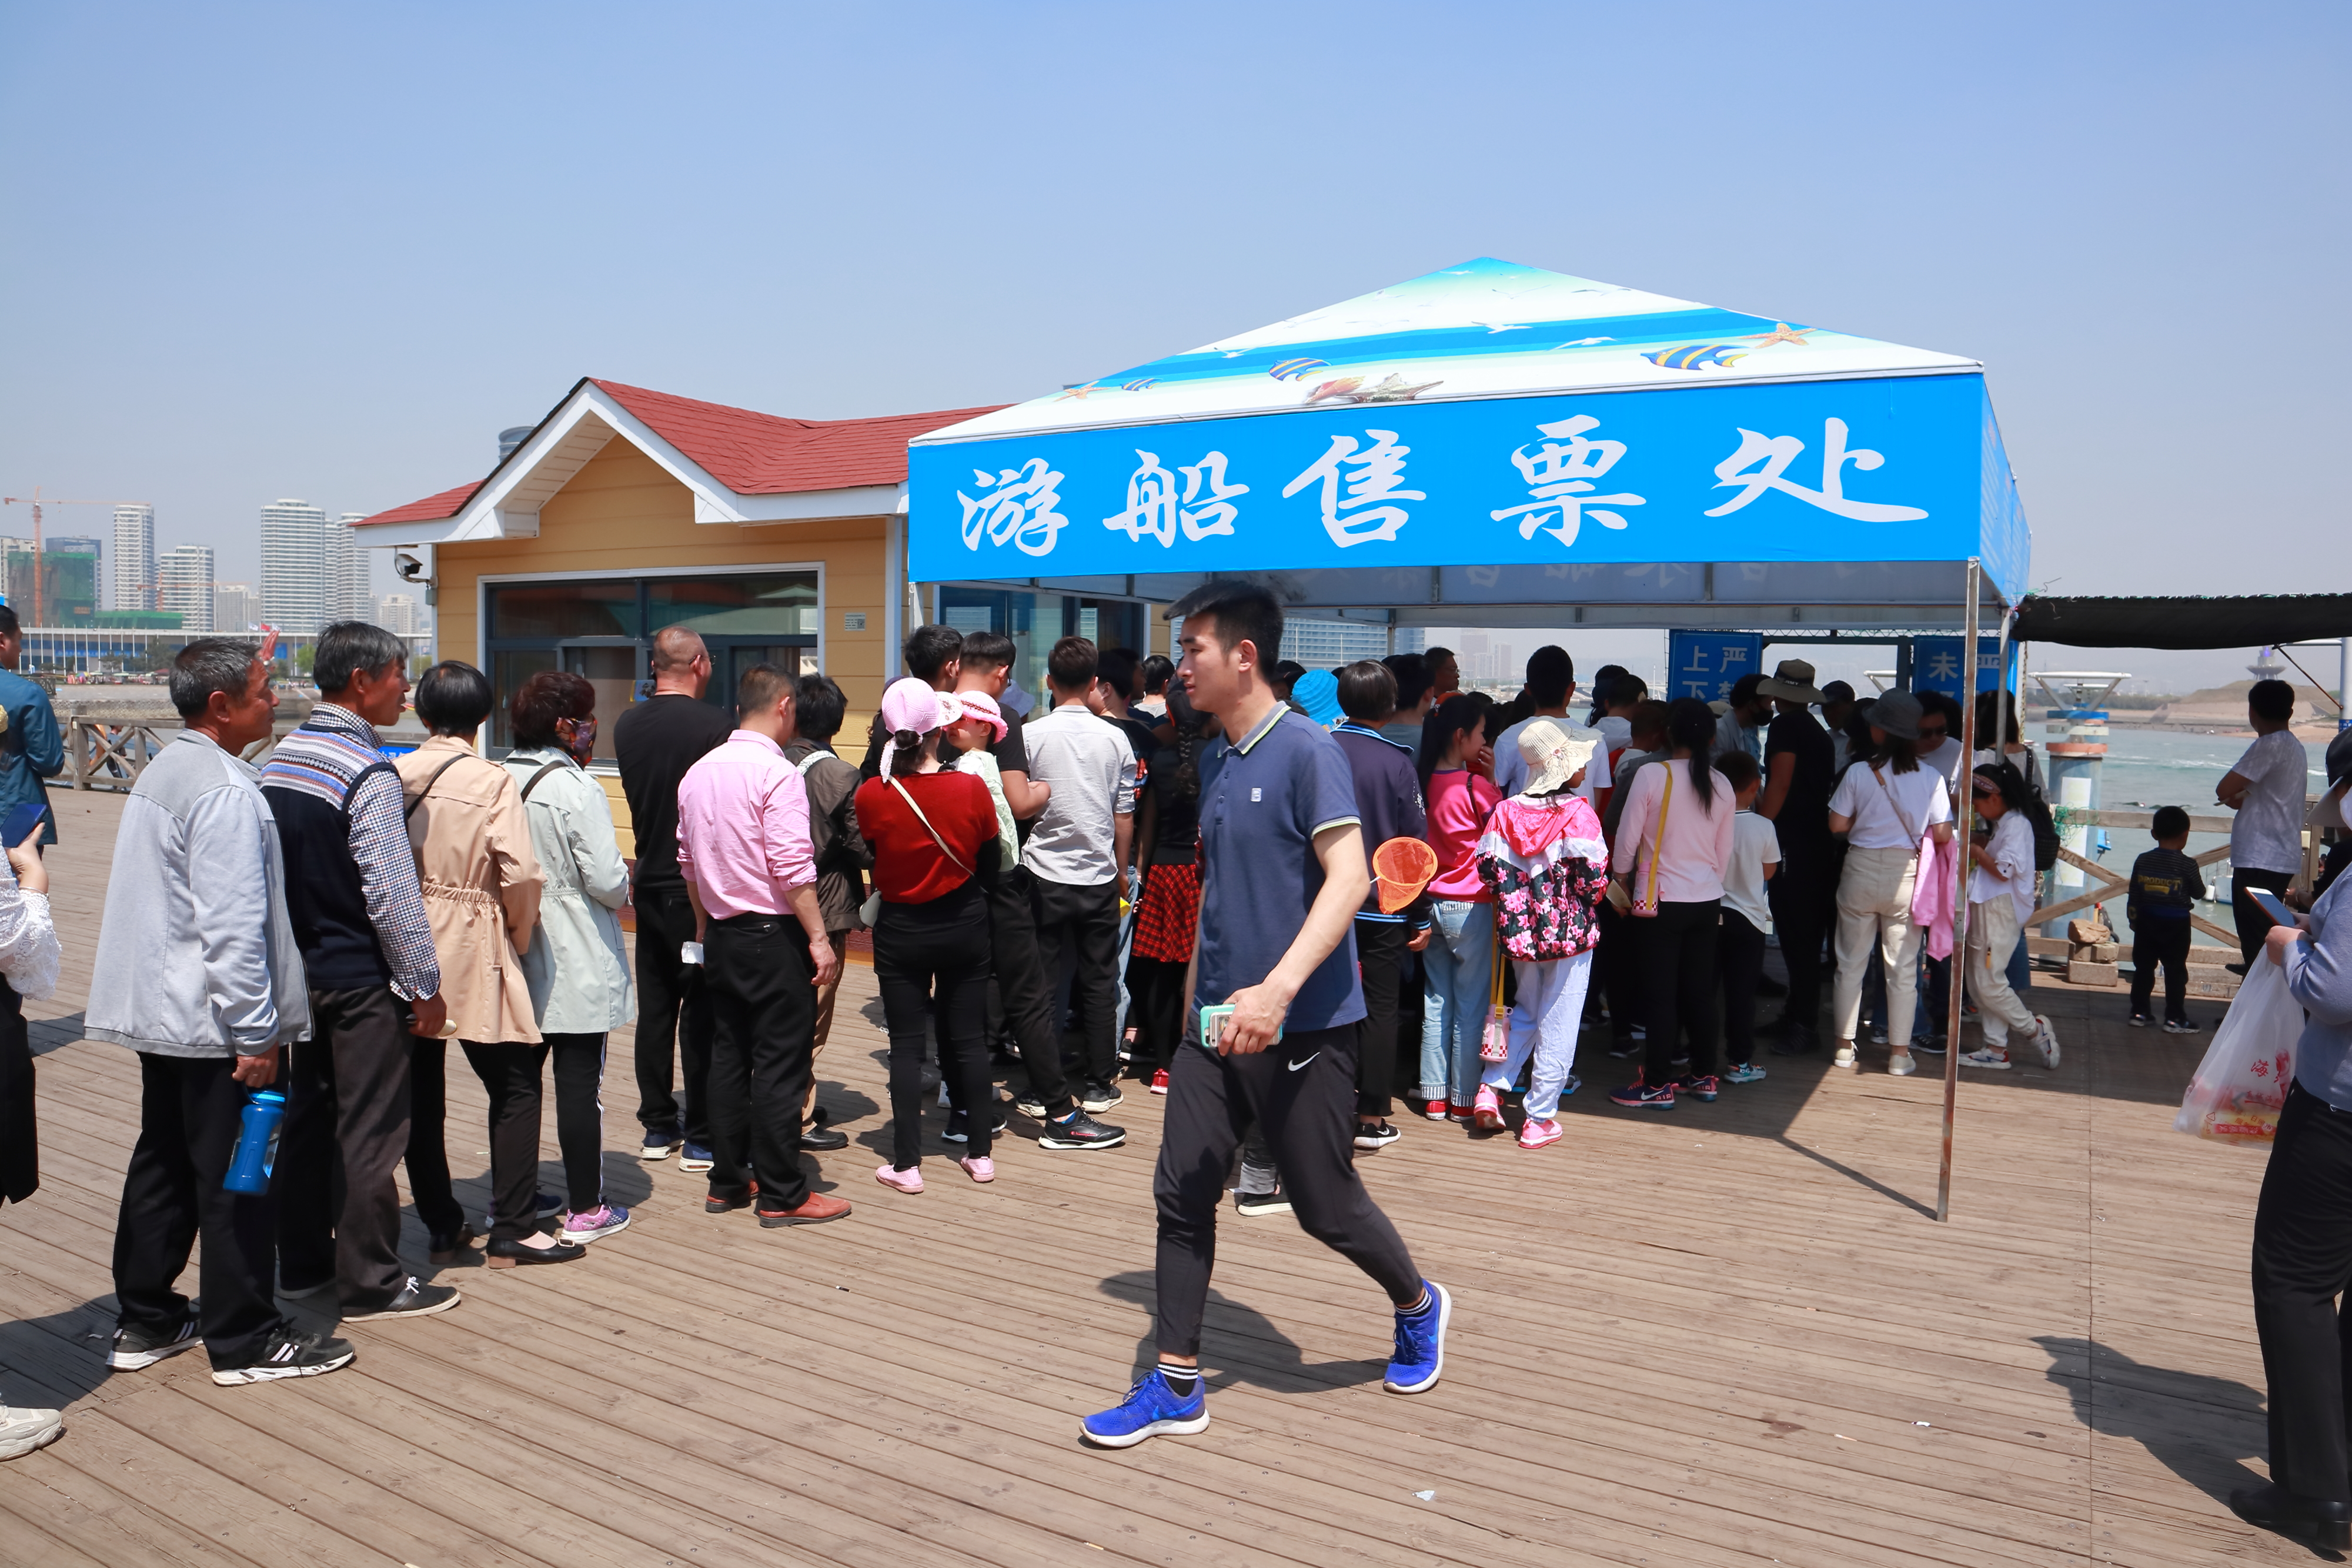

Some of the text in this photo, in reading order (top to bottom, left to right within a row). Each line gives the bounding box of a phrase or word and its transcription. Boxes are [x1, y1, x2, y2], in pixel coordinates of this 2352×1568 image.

[957, 414, 1929, 557] 游船售票处
[2138, 875, 2180, 891] PRODUCT
